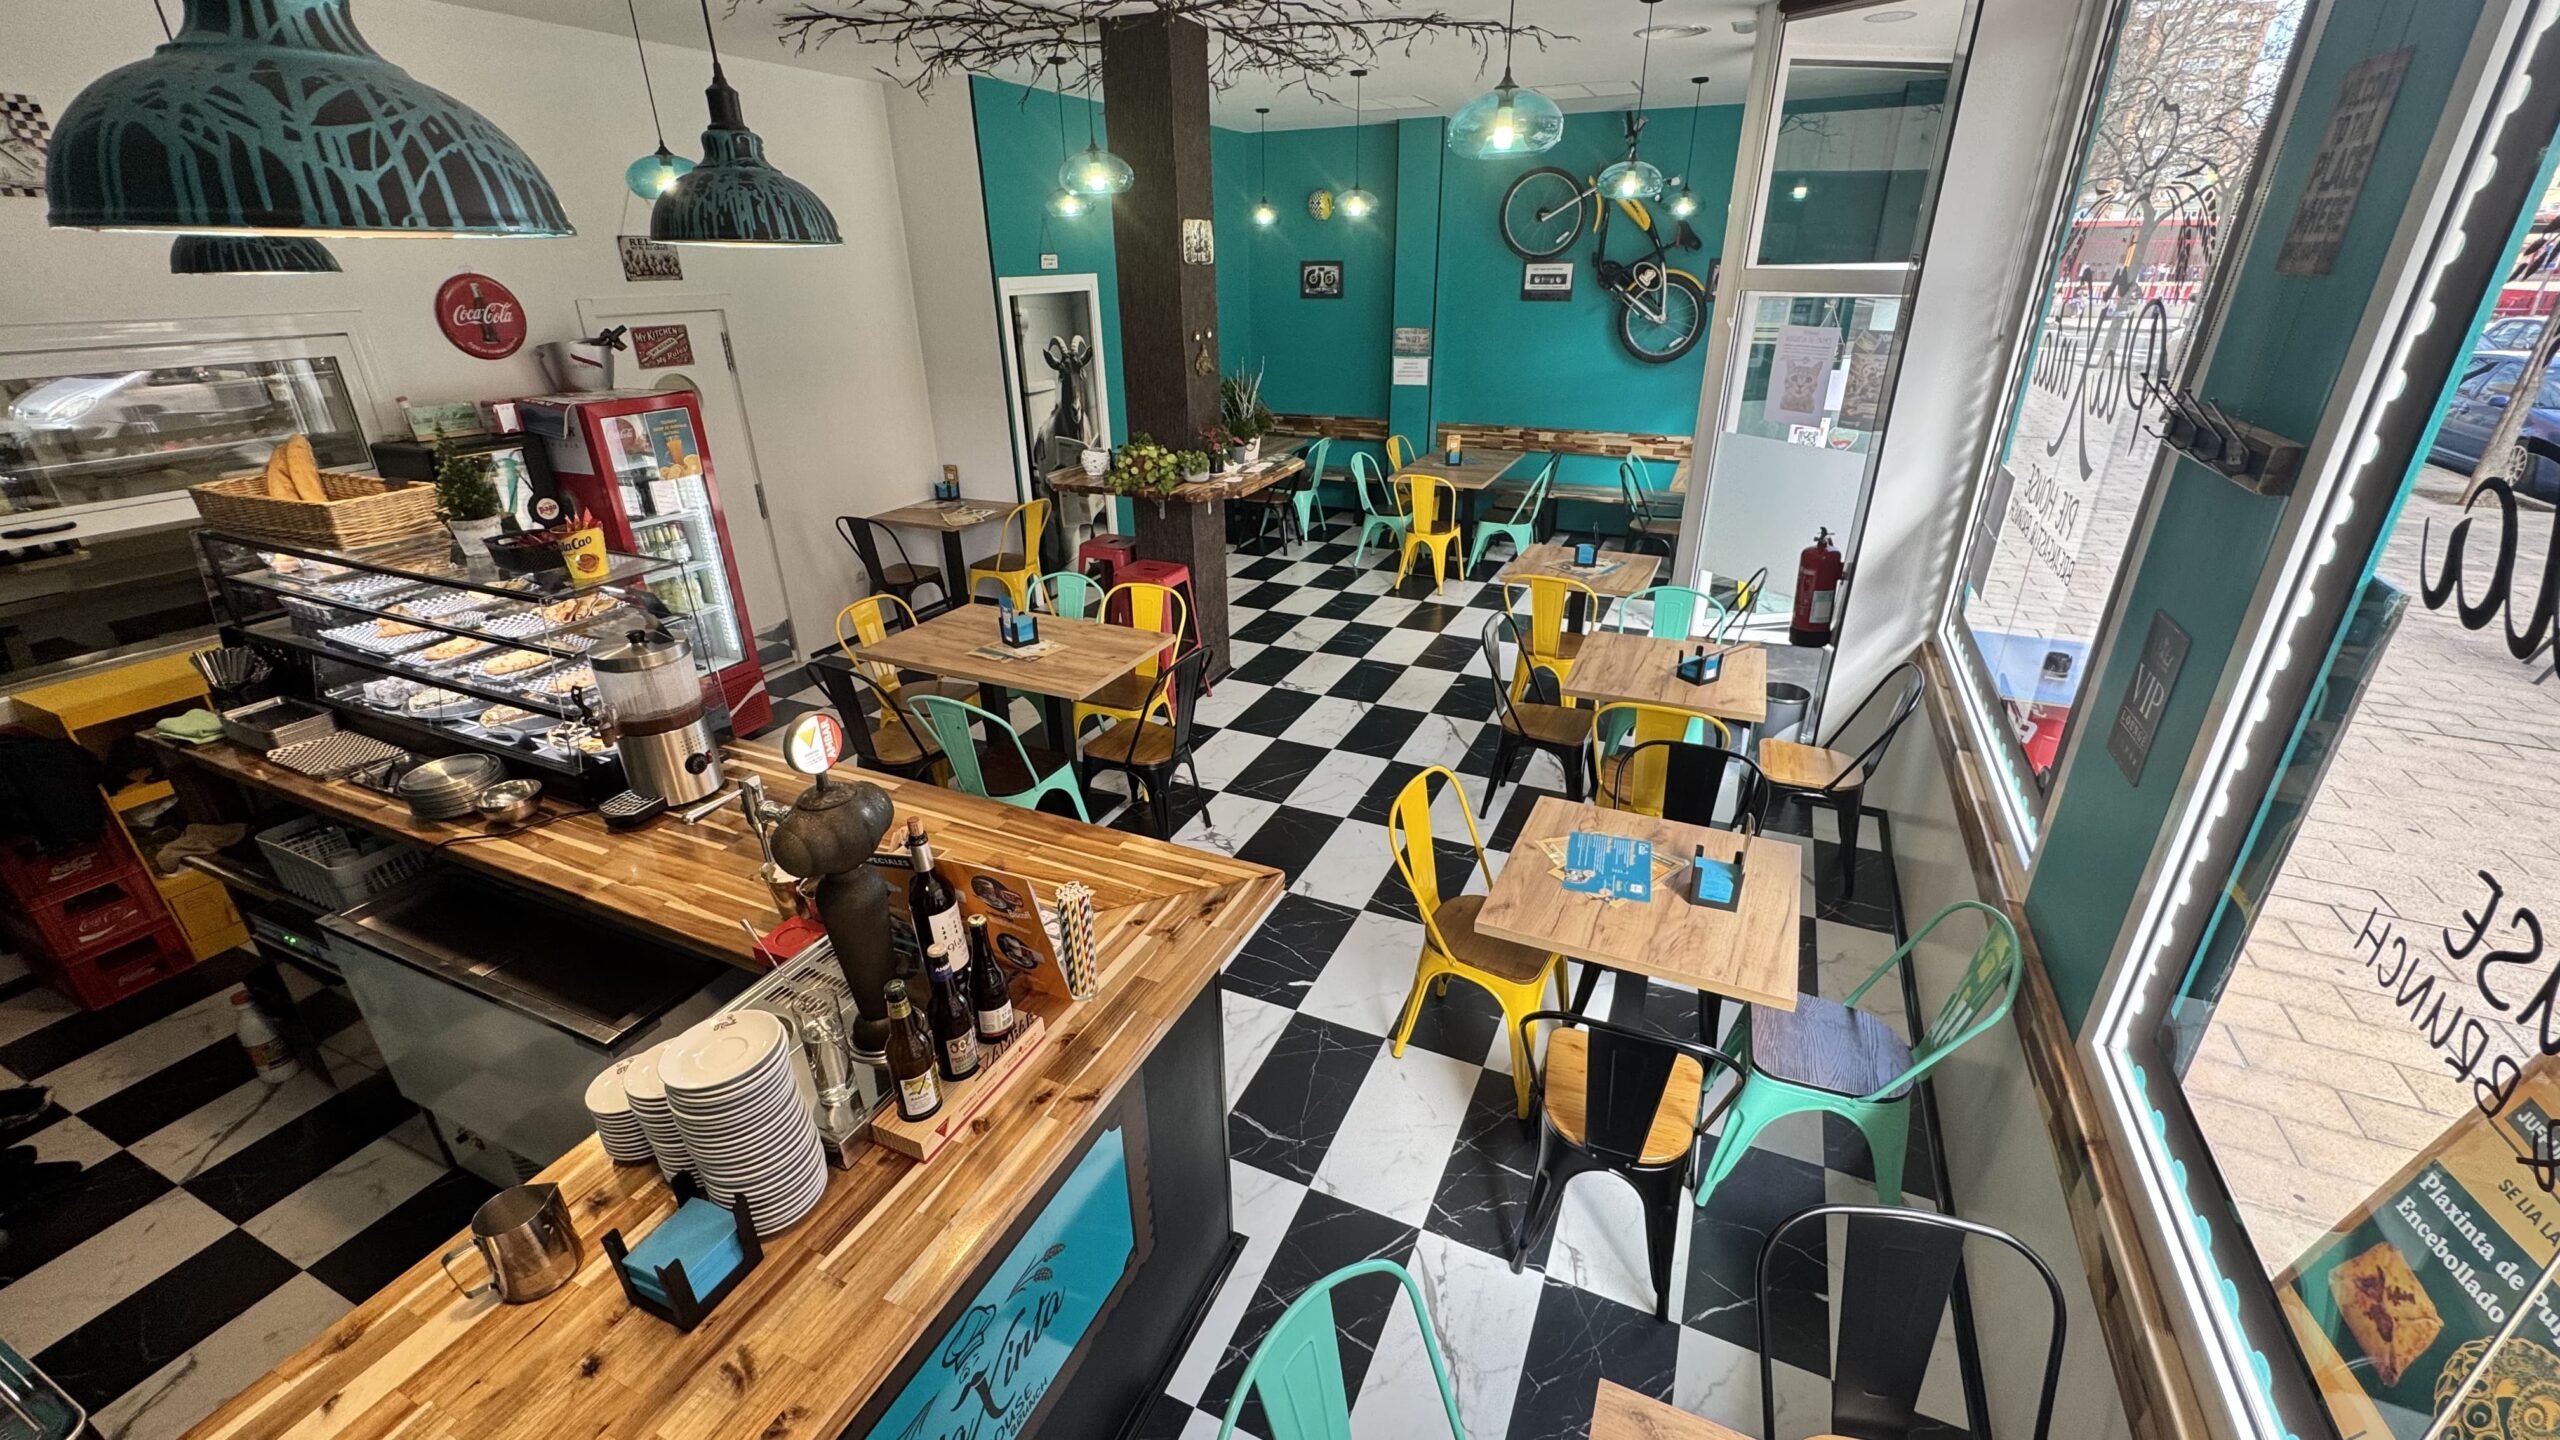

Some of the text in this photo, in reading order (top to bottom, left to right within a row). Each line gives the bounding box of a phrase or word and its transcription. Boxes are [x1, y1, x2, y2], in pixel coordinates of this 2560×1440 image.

[453, 302, 513, 326] Coca-Cola
[647, 327, 678, 342] KITCHEN
[2133, 662, 2165, 720] VIP
[2121, 709, 2149, 748] LOUNGE
[866, 856, 911, 867] PECIALES
[2498, 1178, 2522, 1202] SE
[2516, 1197, 2545, 1227] LIA
[2418, 1171, 2493, 1262] Plaxinta
[2496, 1262, 2526, 1292] de
[2395, 1196, 2506, 1324] Encebollado
[1010, 1377, 1048, 1437] BRUNCH
